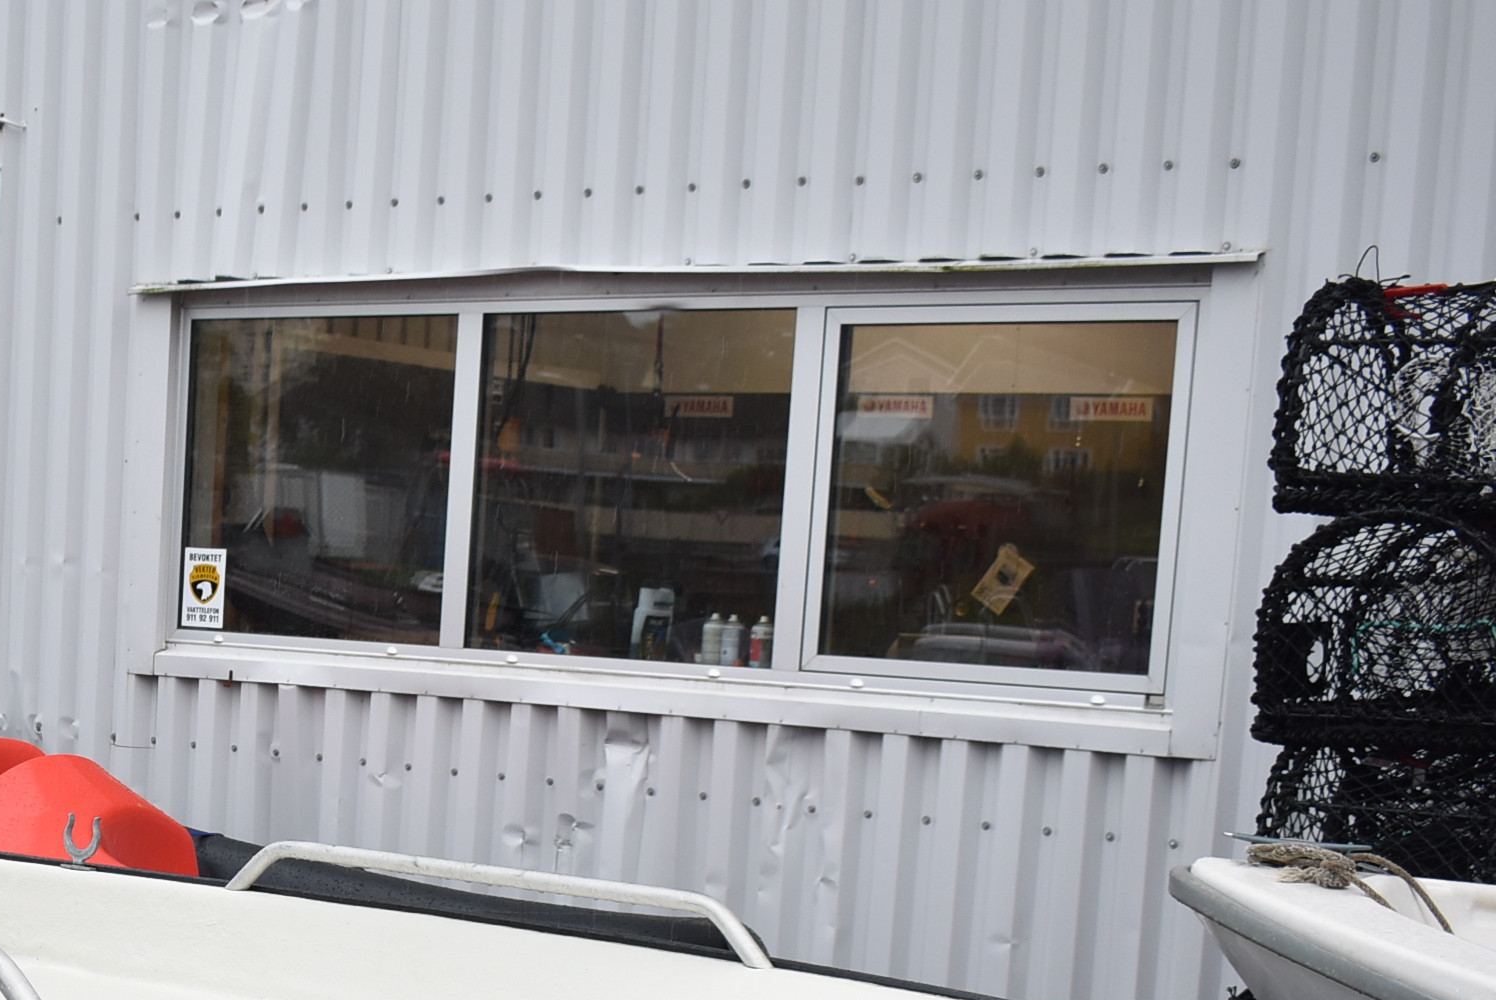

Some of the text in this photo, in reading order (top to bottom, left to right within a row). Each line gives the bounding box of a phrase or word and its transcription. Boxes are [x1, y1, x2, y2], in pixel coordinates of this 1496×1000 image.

[1092, 401, 1146, 416] YAMAHA
[189, 553, 222, 562] BEVOKTET
[186, 614, 220, 623] 911 92 911
